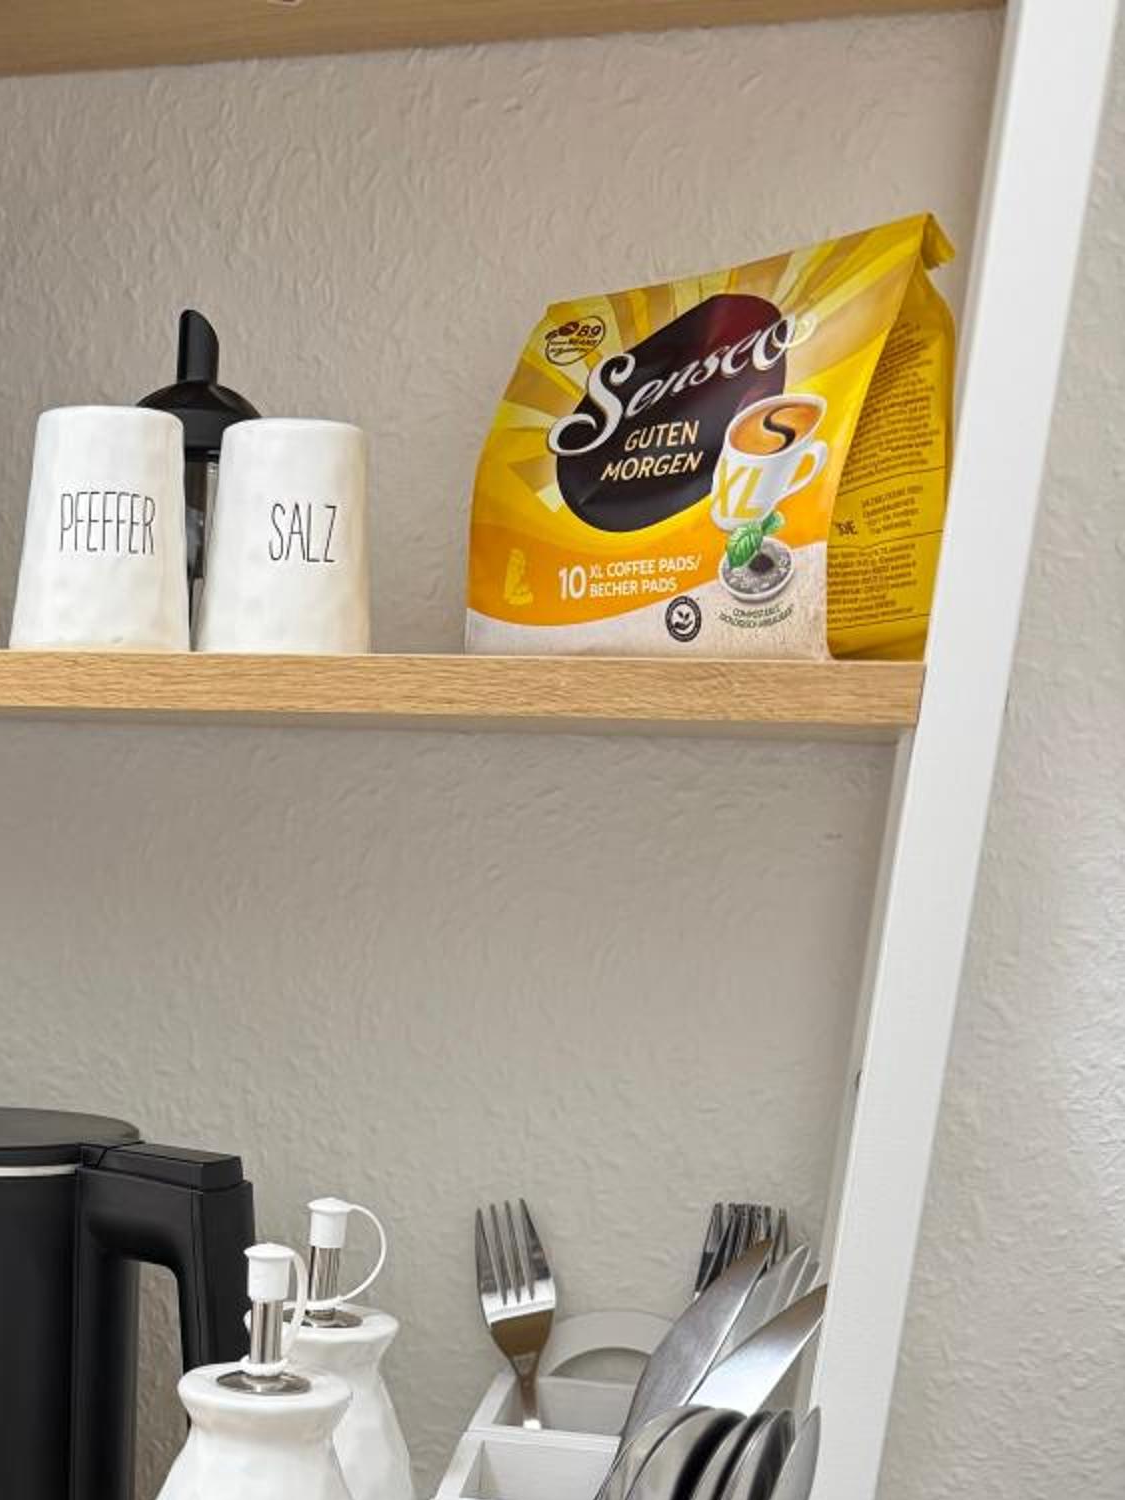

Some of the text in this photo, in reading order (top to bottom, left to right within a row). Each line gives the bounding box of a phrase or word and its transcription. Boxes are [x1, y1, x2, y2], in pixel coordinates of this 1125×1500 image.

[548, 313, 817, 457] Senseo
[624, 420, 699, 452] GUTEN
[600, 451, 703, 481] MORGEN
[59, 491, 156, 556] PFEFFER
[268, 503, 338, 563] SALZ
[558, 564, 587, 600] 10
[589, 564, 604, 579] XL
[606, 559, 656, 578] COFFEE
[589, 577, 678, 598] BECHER PADS
